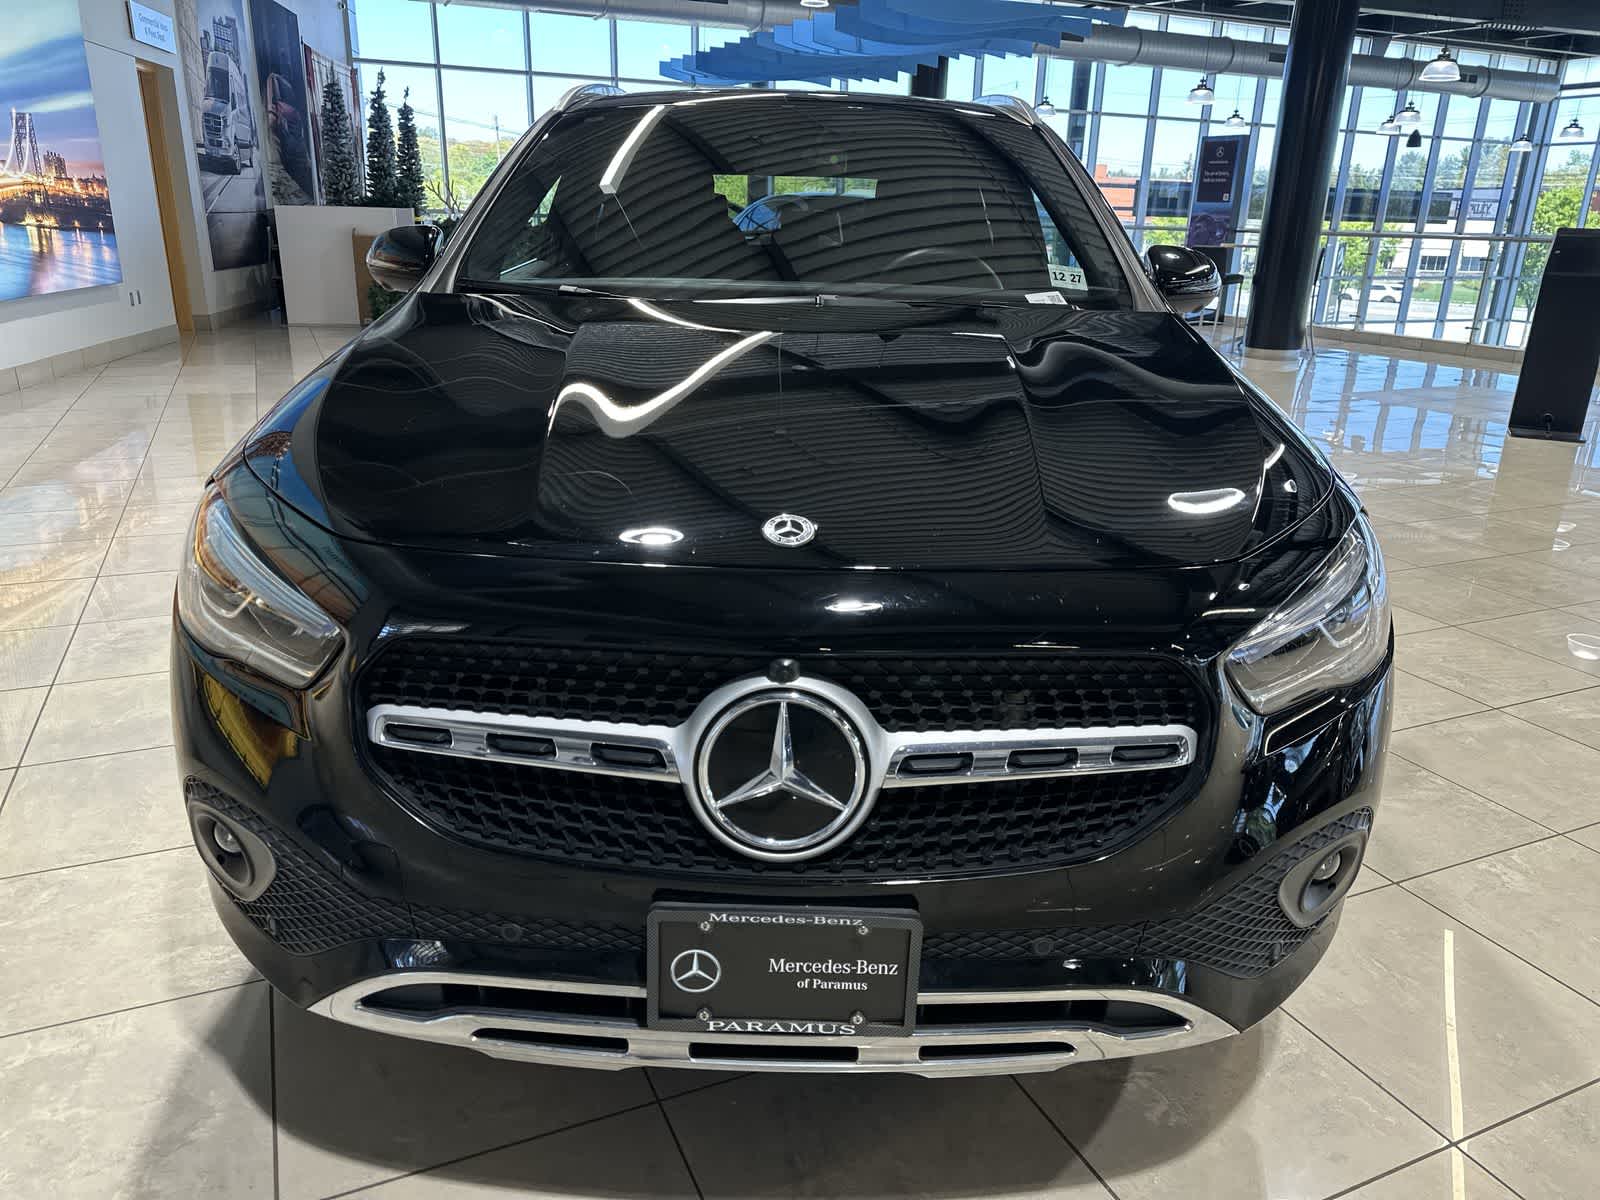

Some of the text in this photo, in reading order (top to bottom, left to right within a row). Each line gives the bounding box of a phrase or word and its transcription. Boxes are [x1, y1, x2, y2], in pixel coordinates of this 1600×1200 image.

[1052, 271, 1082, 283] 12 27
[708, 913, 864, 926] Mercedes-Benz
[768, 958, 898, 975] Mercedes-Benz
[797, 978, 868, 990] of Paramus
[706, 1020, 856, 1035] PARAMUS
